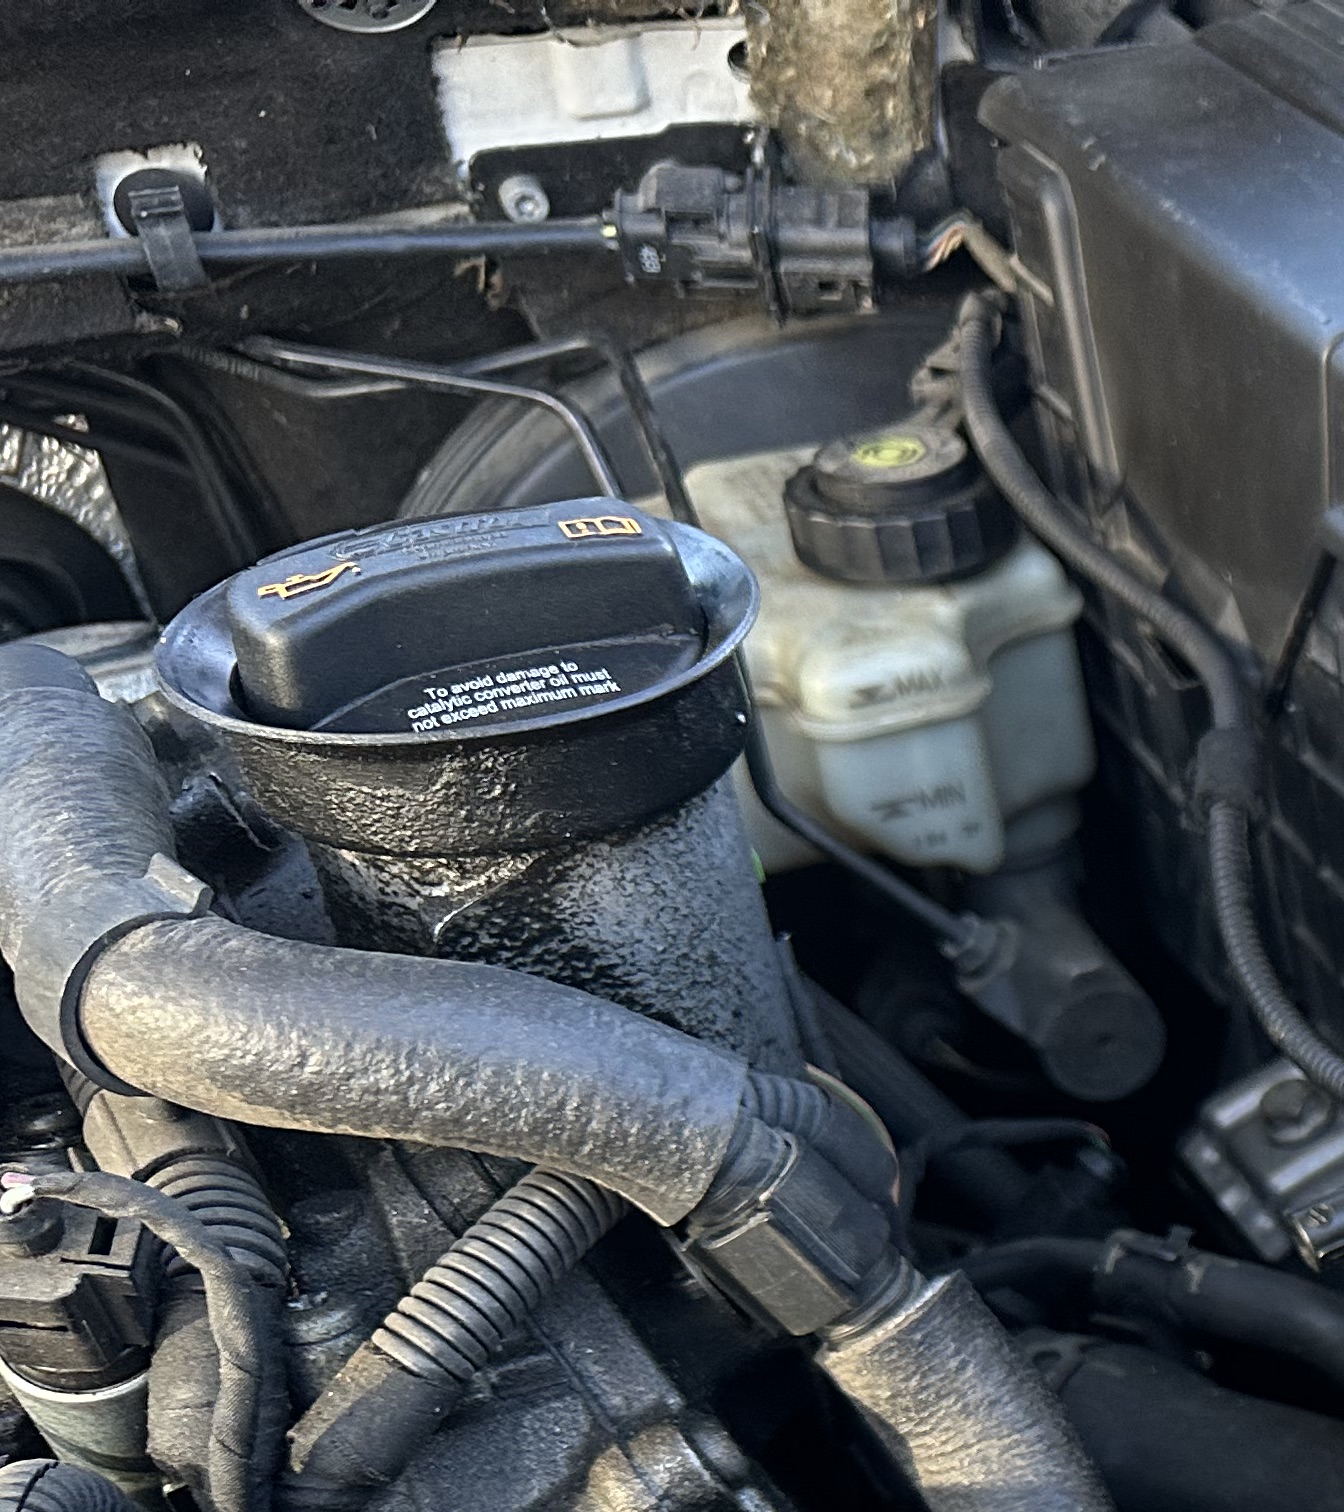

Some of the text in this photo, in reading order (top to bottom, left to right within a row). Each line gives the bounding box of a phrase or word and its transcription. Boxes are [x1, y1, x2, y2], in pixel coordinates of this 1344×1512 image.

[407, 666, 613, 719] catalytic converter oil must
[411, 679, 622, 733] not exceed maximum mark
[423, 660, 579, 700] To avoid damage to
